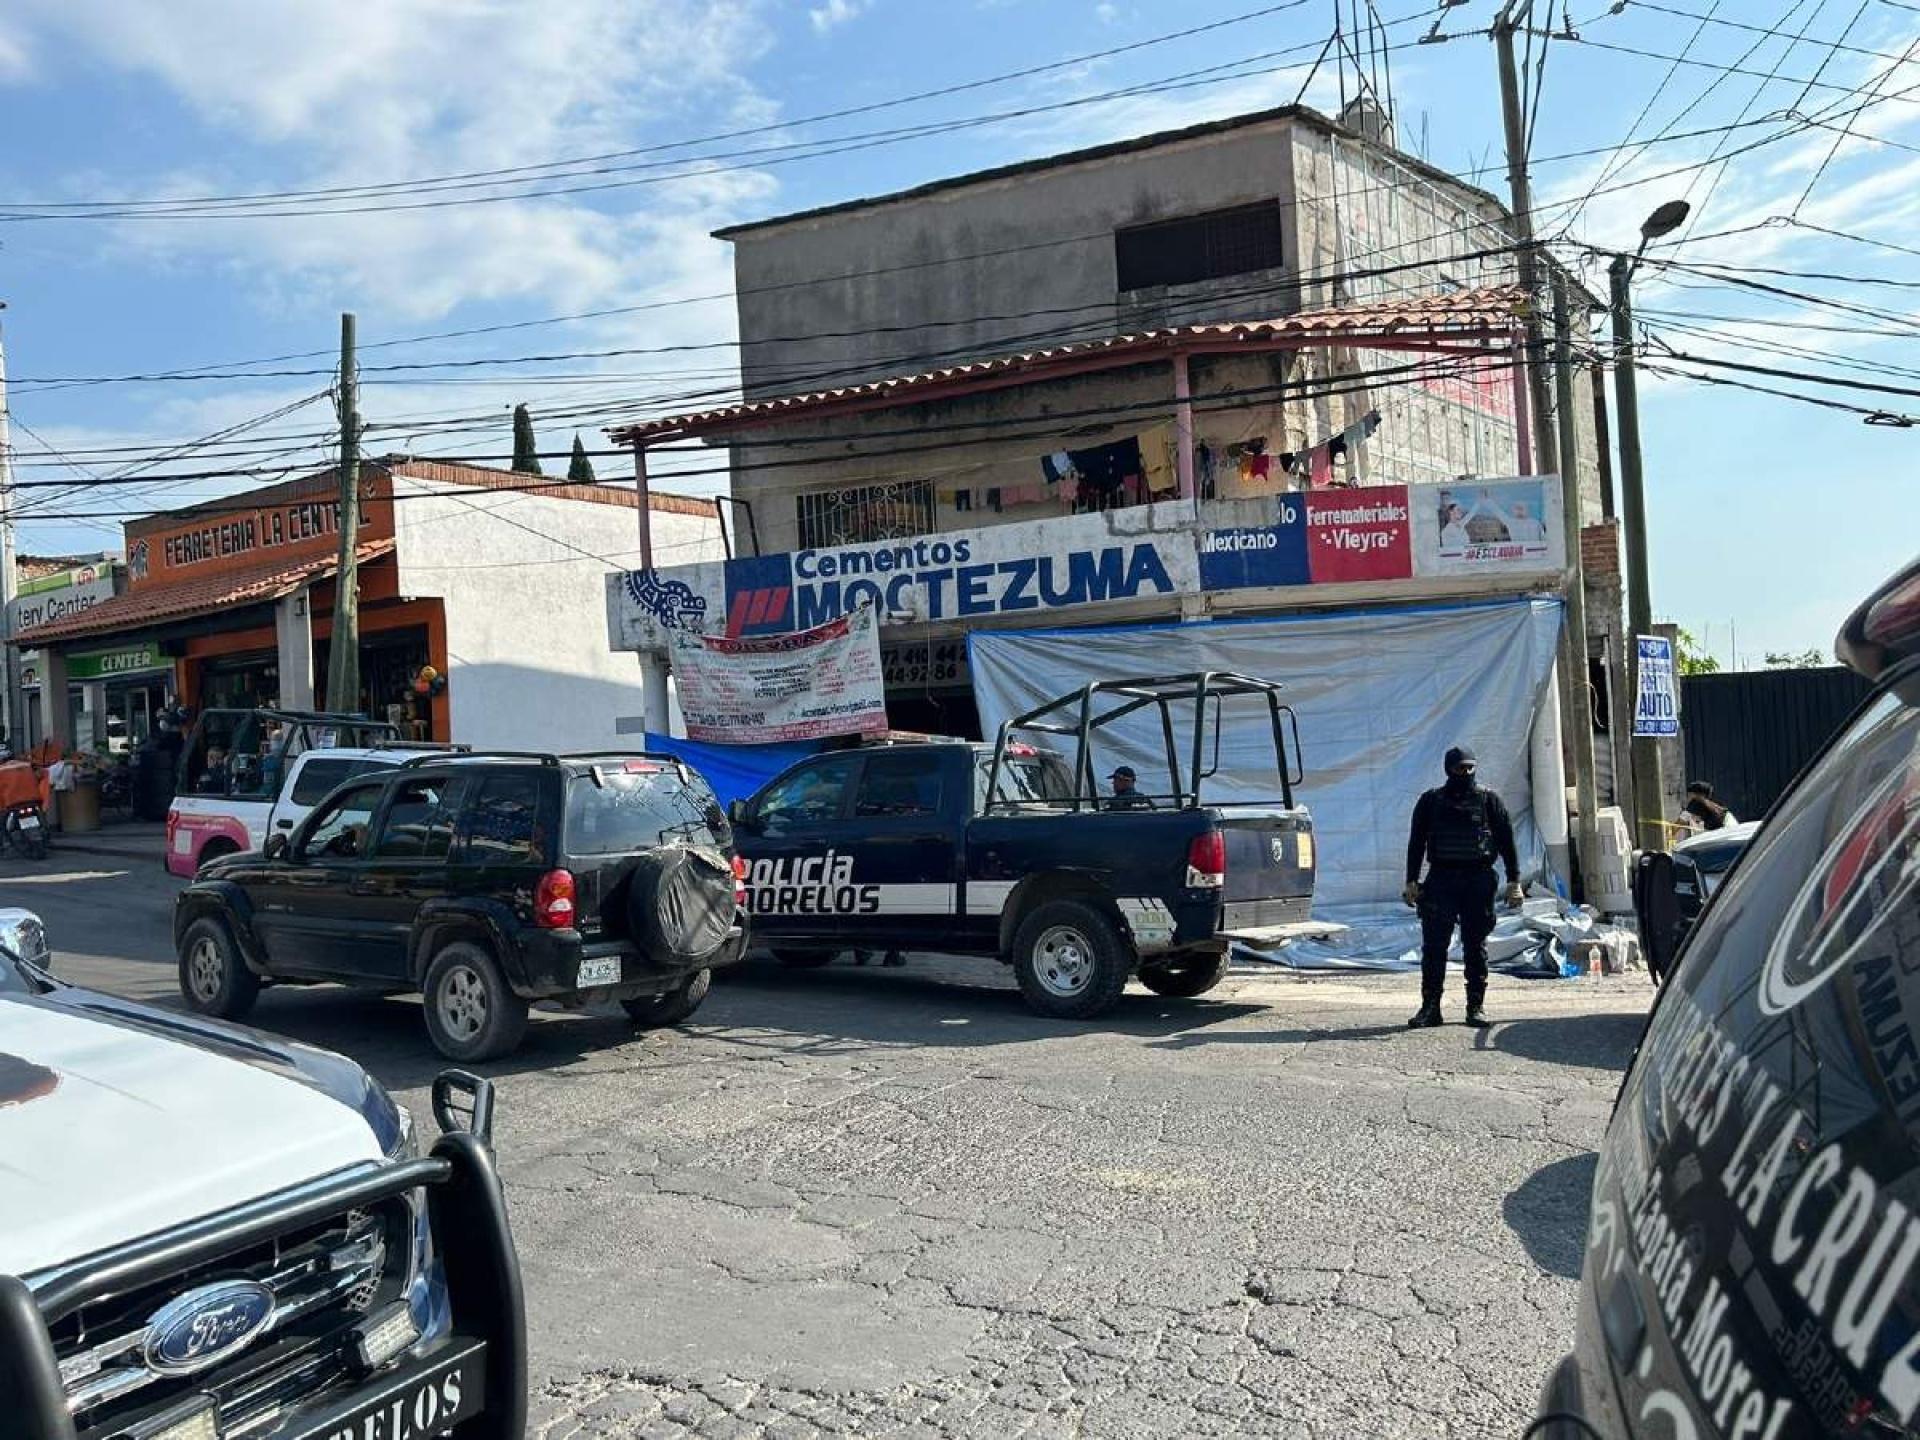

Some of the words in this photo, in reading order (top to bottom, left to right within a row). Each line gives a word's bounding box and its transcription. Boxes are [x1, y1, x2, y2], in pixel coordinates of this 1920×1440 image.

[1306, 501, 1407, 526] Ferremateriales
[164, 519, 256, 568] FERRETERIA
[260, 509, 284, 547] LA
[287, 499, 372, 543] CENTRL
[1201, 530, 1278, 553] Mexicano
[1332, 527, 1389, 553] Vieyra
[795, 538, 970, 579] Cementos
[796, 543, 1174, 629] MOCTEZUMA
[47, 593, 97, 622] Center
[101, 650, 152, 671] CENTER
[1639, 692, 1673, 716] AUTO
[186, 1304, 250, 1358] Ford
[329, 1369, 462, 1440] ELOS
